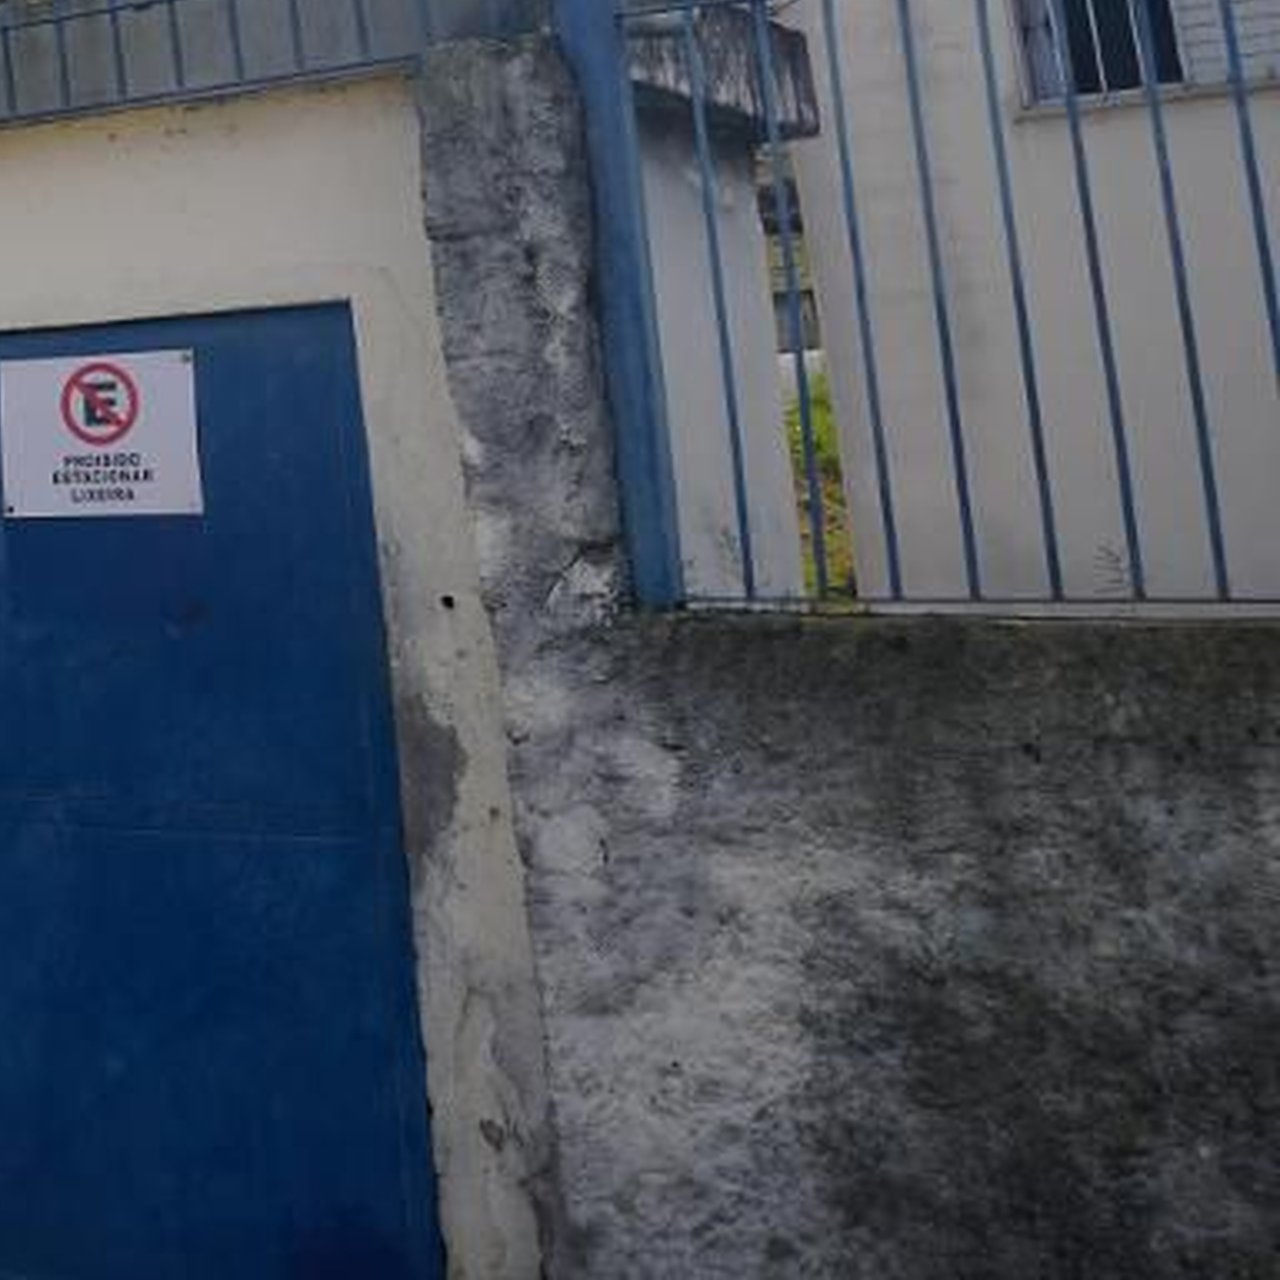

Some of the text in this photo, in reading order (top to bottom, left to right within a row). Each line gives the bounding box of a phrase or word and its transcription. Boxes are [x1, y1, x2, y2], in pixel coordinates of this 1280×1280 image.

[63, 452, 141, 468] PROIBIDO
[53, 469, 154, 485] ESTACIONAR
[71, 487, 134, 503] LIXEIRA
